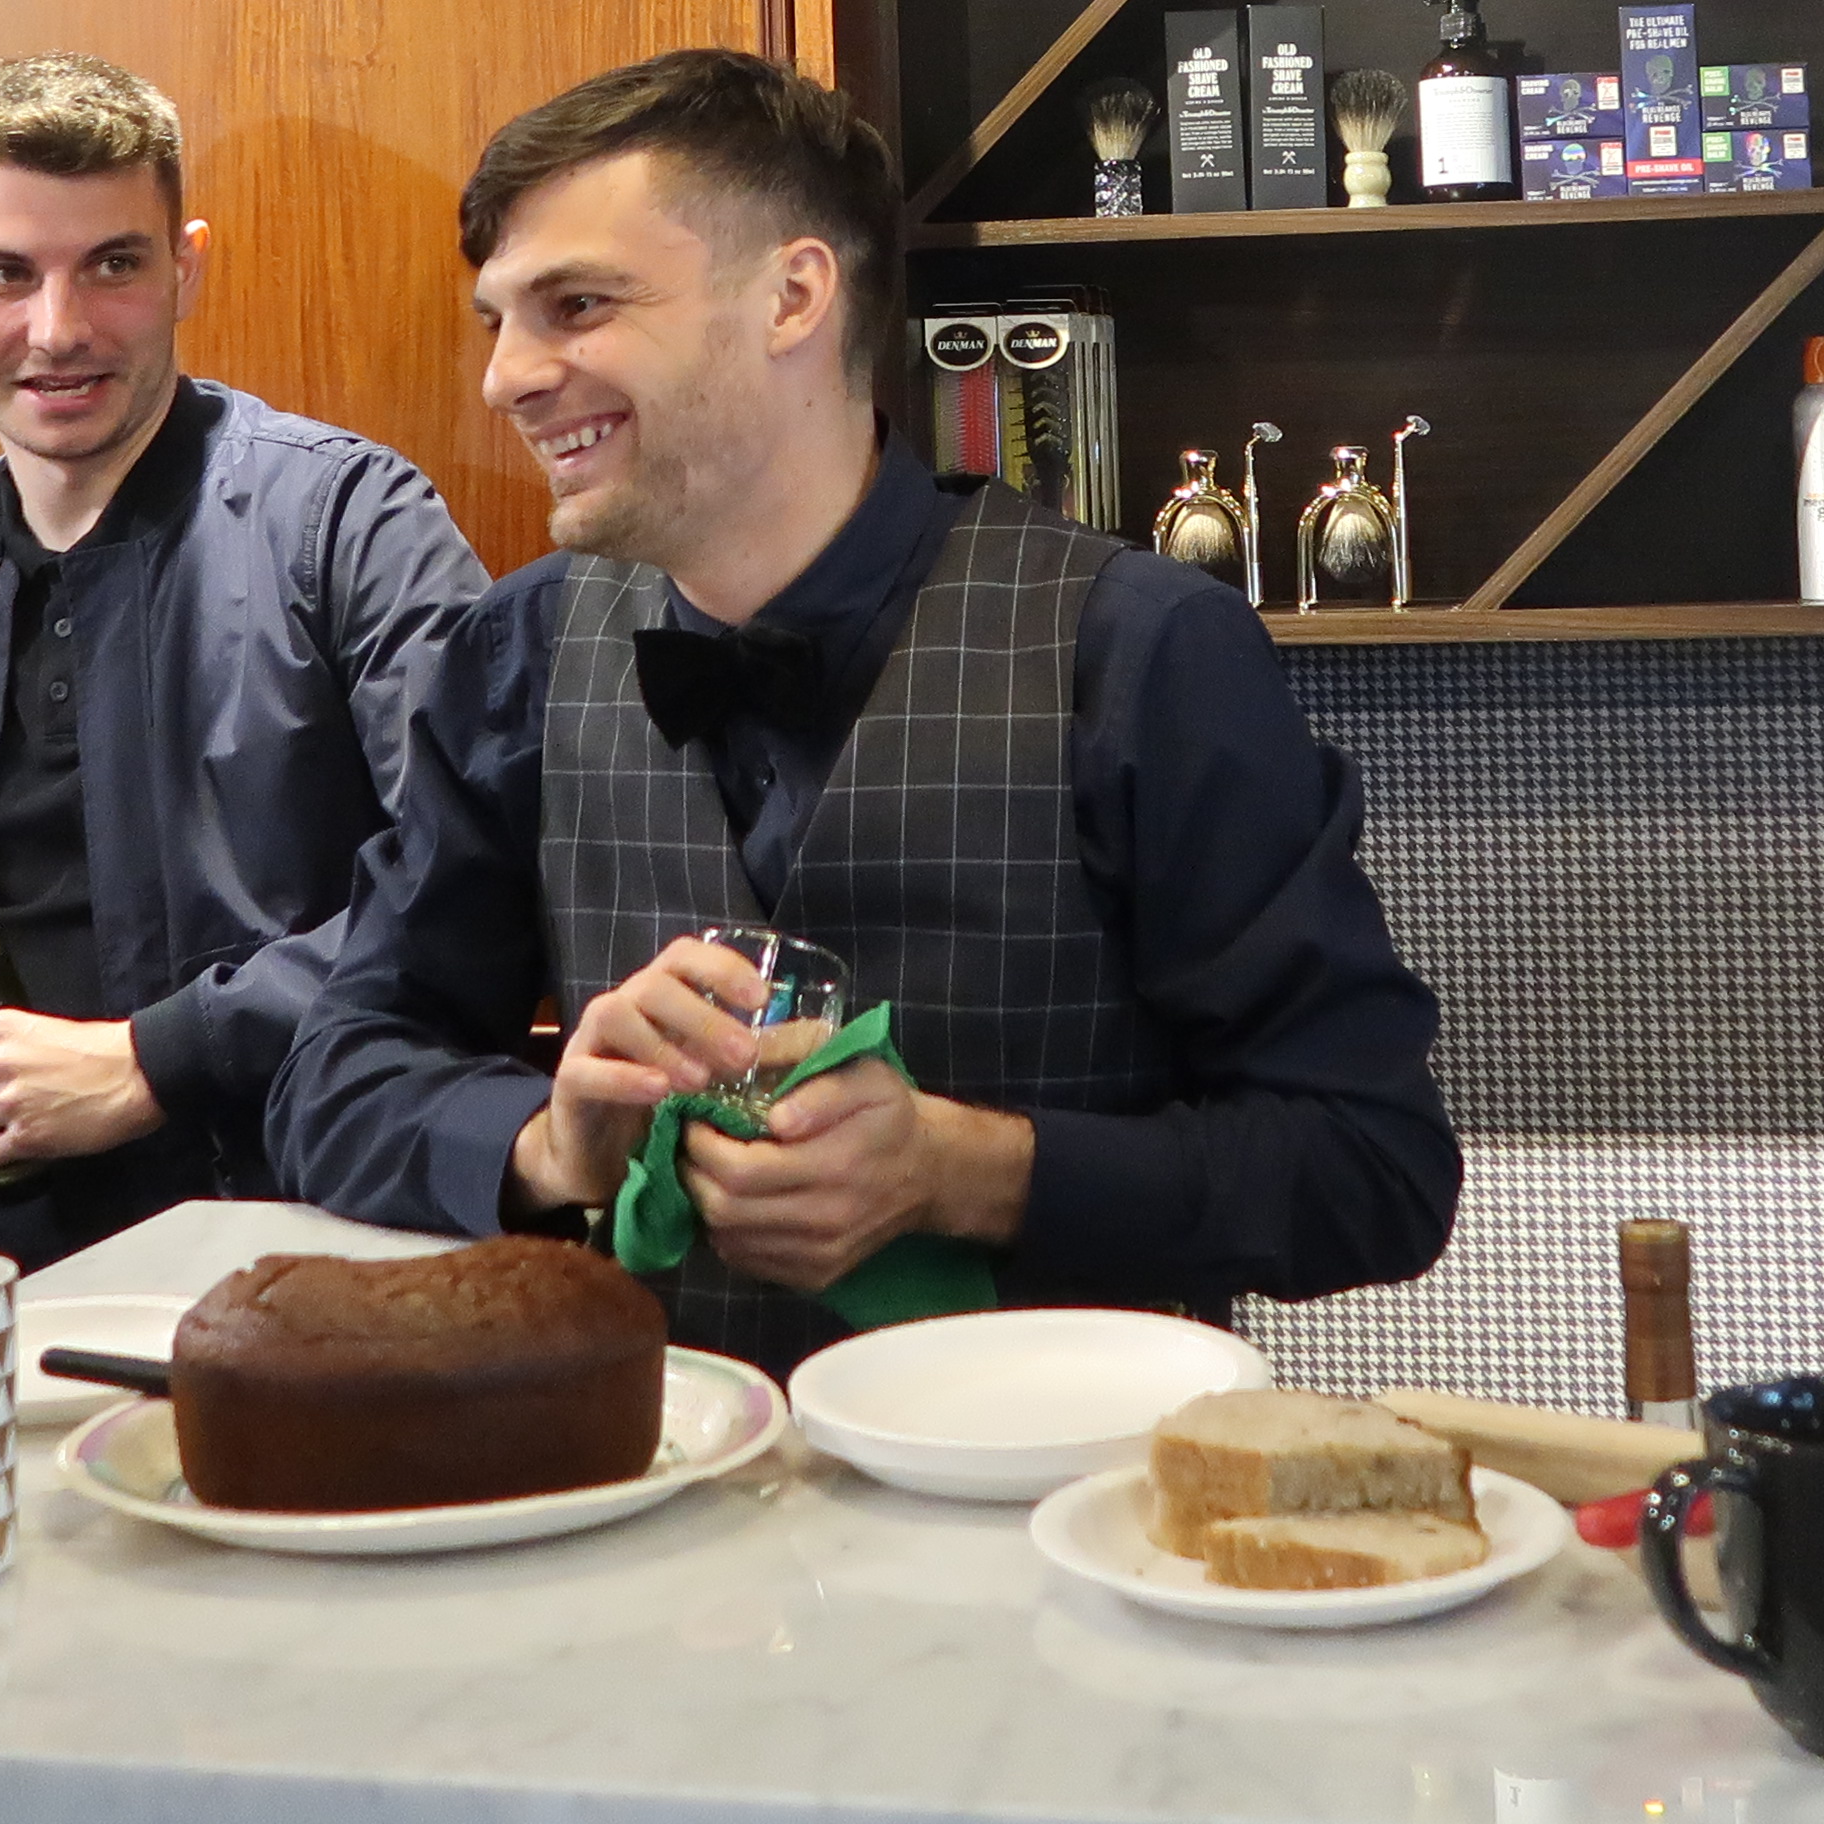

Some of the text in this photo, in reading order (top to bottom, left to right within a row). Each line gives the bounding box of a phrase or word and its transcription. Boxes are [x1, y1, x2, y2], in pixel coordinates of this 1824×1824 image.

[1192, 47, 1212, 60] OLD
[1277, 43, 1297, 56] OLD
[1177, 59, 1229, 73] FASHIONED
[1262, 56, 1313, 69] FASHIONED
[1188, 72, 1218, 85] SHAVE
[1272, 69, 1302, 81] SHAVE
[1188, 84, 1220, 98] CREAM
[1271, 82, 1304, 95] CREAM
[937, 340, 985, 352] DENMAN
[1010, 337, 1057, 350] DENMAN
